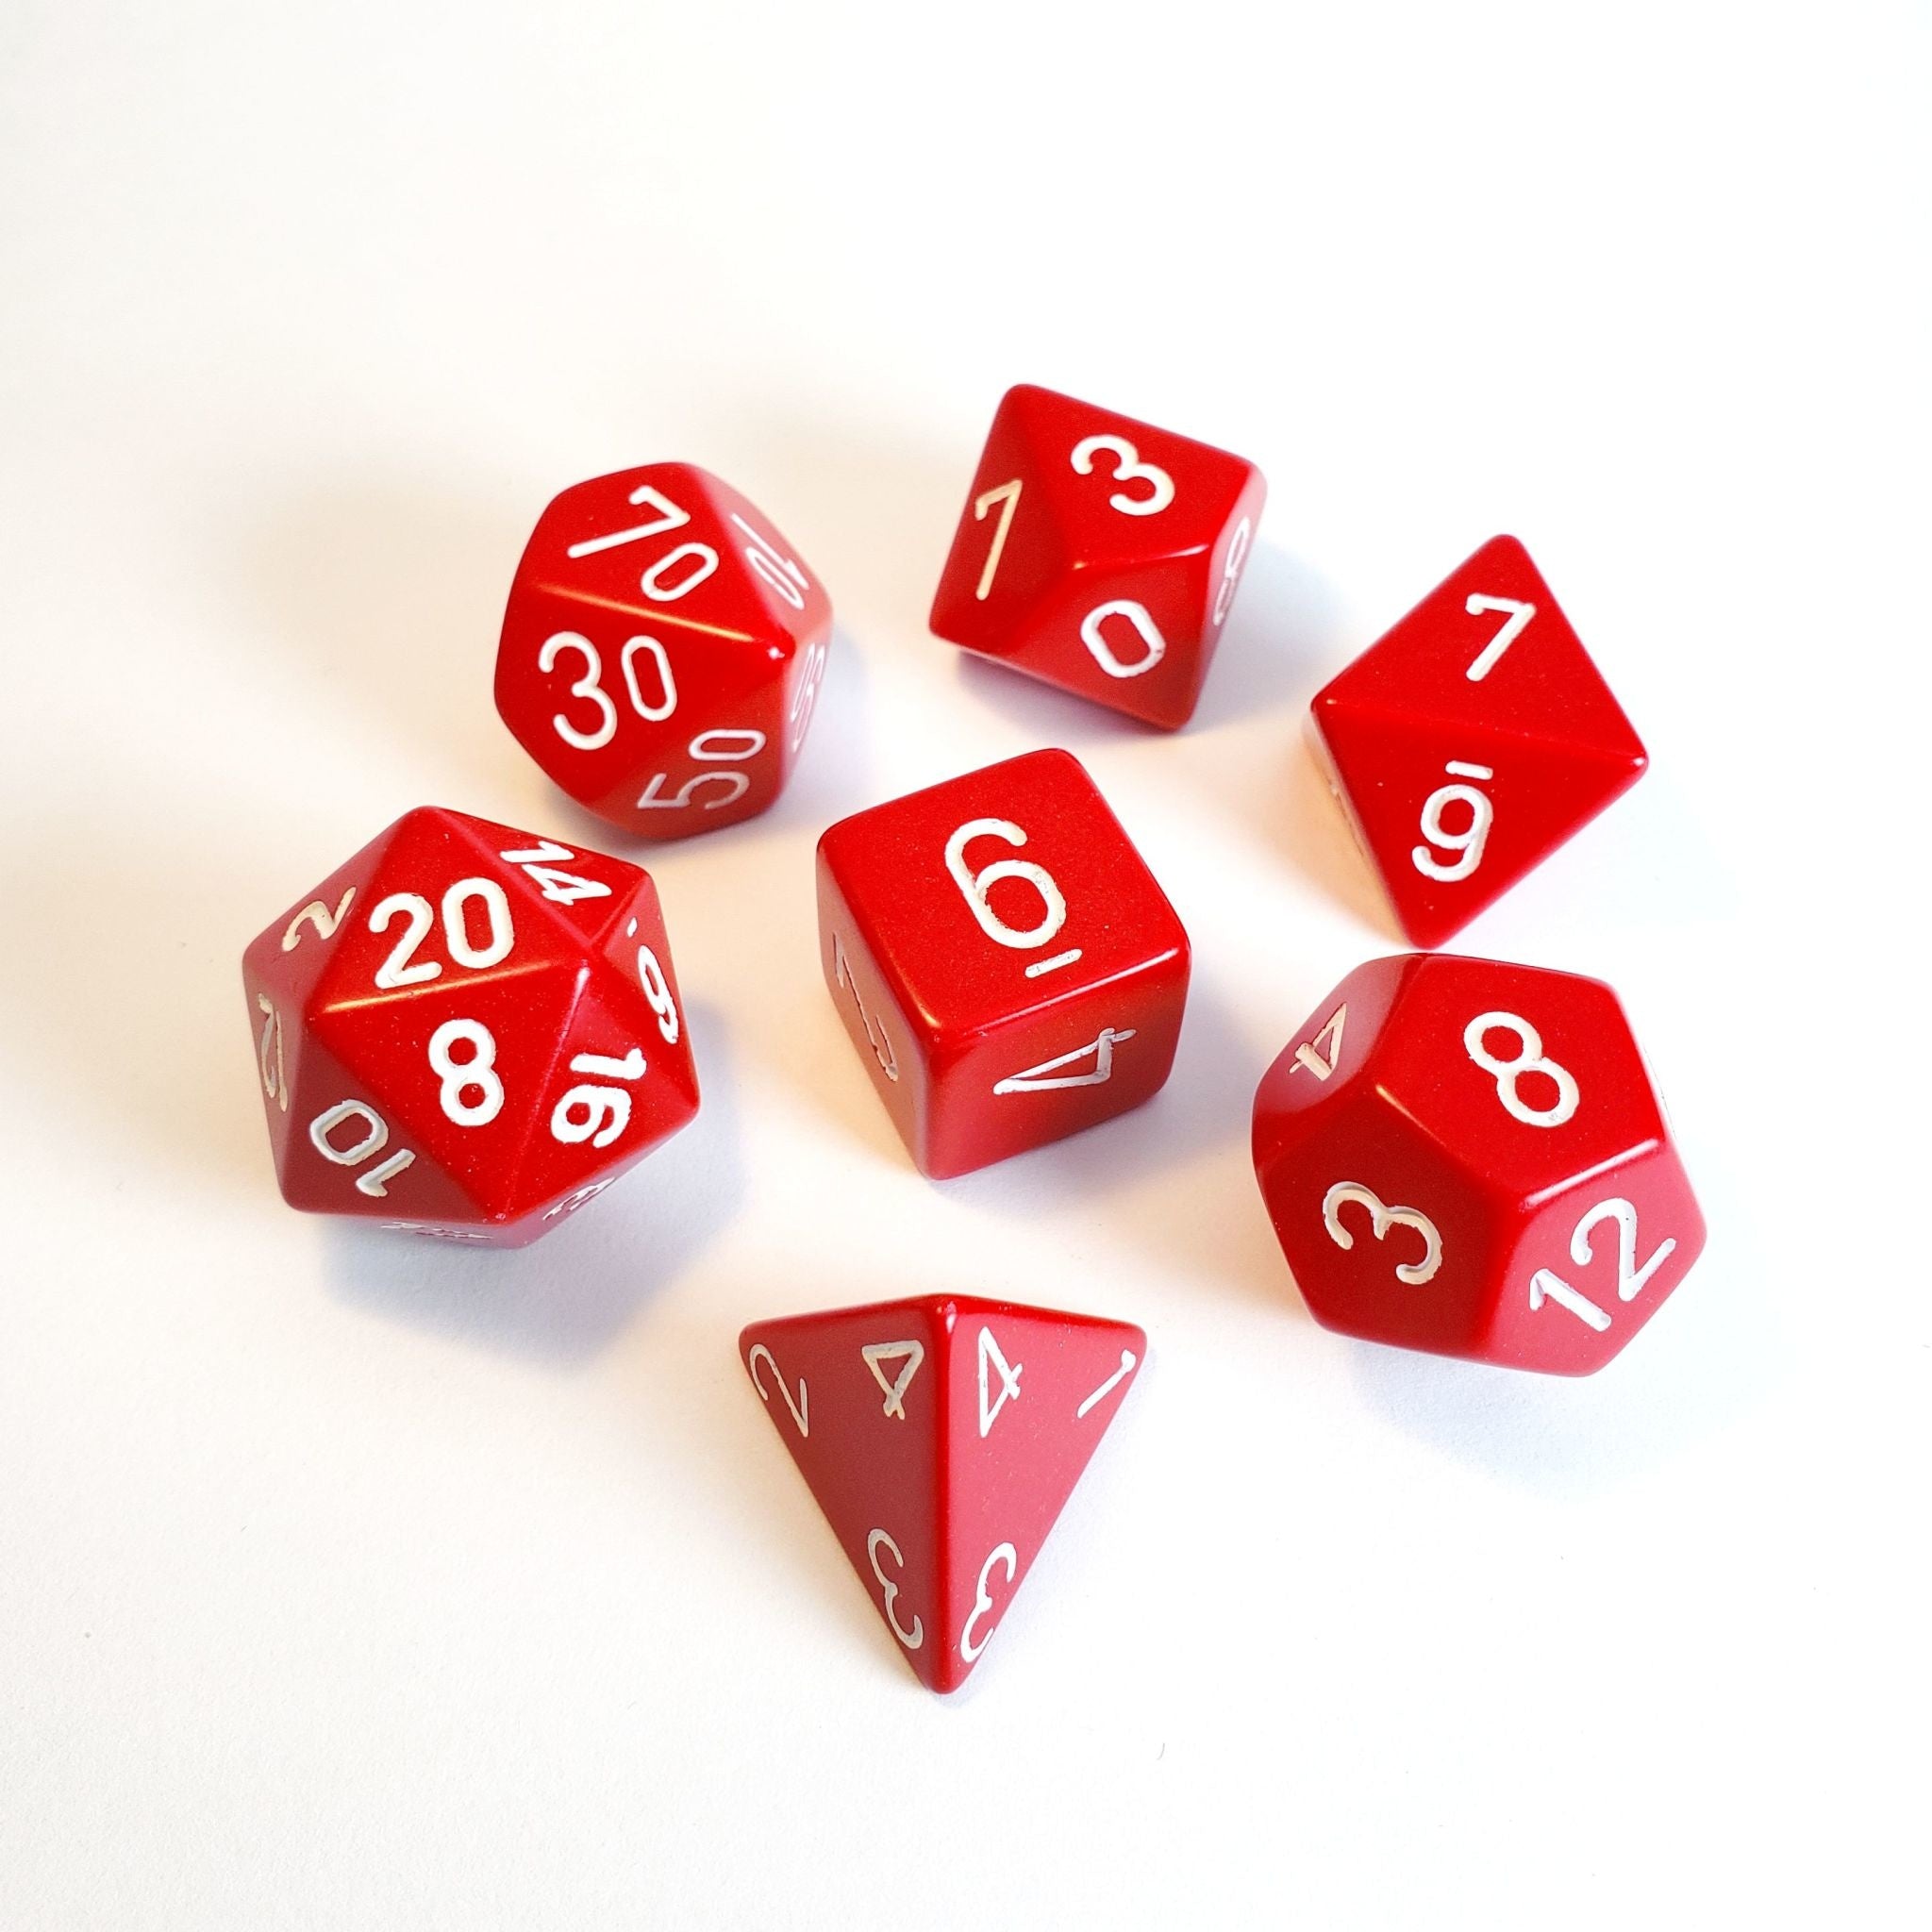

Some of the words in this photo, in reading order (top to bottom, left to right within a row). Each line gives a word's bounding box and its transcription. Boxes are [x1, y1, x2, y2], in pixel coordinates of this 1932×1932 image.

[1070, 434, 1175, 516] 3
[567, 484, 719, 603] 70
[1079, 599, 1167, 679] 0
[538, 631, 678, 751] 30
[637, 727, 767, 809] 50
[281, 885, 358, 953] 2
[500, 841, 613, 906] 14
[944, 817, 1083, 979] 6
[368, 875, 515, 990] 20
[427, 1018, 505, 1128] 8
[993, 1026, 1138, 1096] 4
[1289, 1001, 1350, 1083] 4
[1463, 1010, 1581, 1129] 8
[308, 1098, 417, 1198] 10
[550, 1046, 648, 1149] 16
[1322, 1180, 1444, 1286] 3
[1529, 1196, 1677, 1333] 12
[748, 1343, 809, 1439] 2
[861, 1339, 925, 1421] 4
[977, 1325, 1024, 1439] 4
[1076, 1348, 1138, 1419] 1
[867, 1527, 924, 1650] 3
[959, 1541, 1017, 1664] 3
